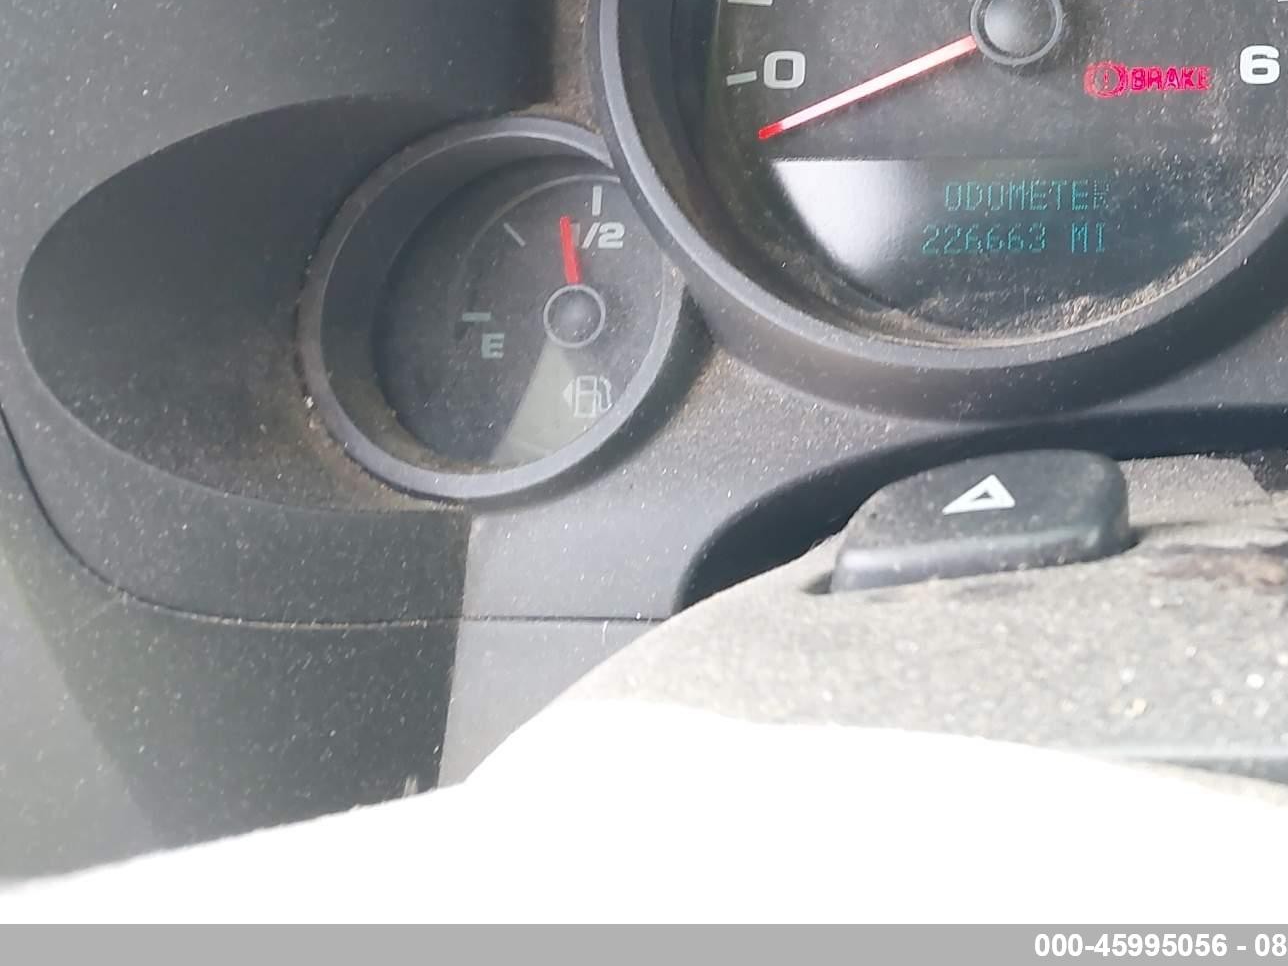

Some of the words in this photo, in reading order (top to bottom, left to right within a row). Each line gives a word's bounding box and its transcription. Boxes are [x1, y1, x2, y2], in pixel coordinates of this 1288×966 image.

[763, 49, 806, 90] 0
[1130, 65, 1211, 92] BRAKE
[1239, 44, 1280, 85] 6
[943, 179, 1110, 211] ODOMETER
[1071, 220, 1106, 254] MI
[481, 332, 505, 359] E
